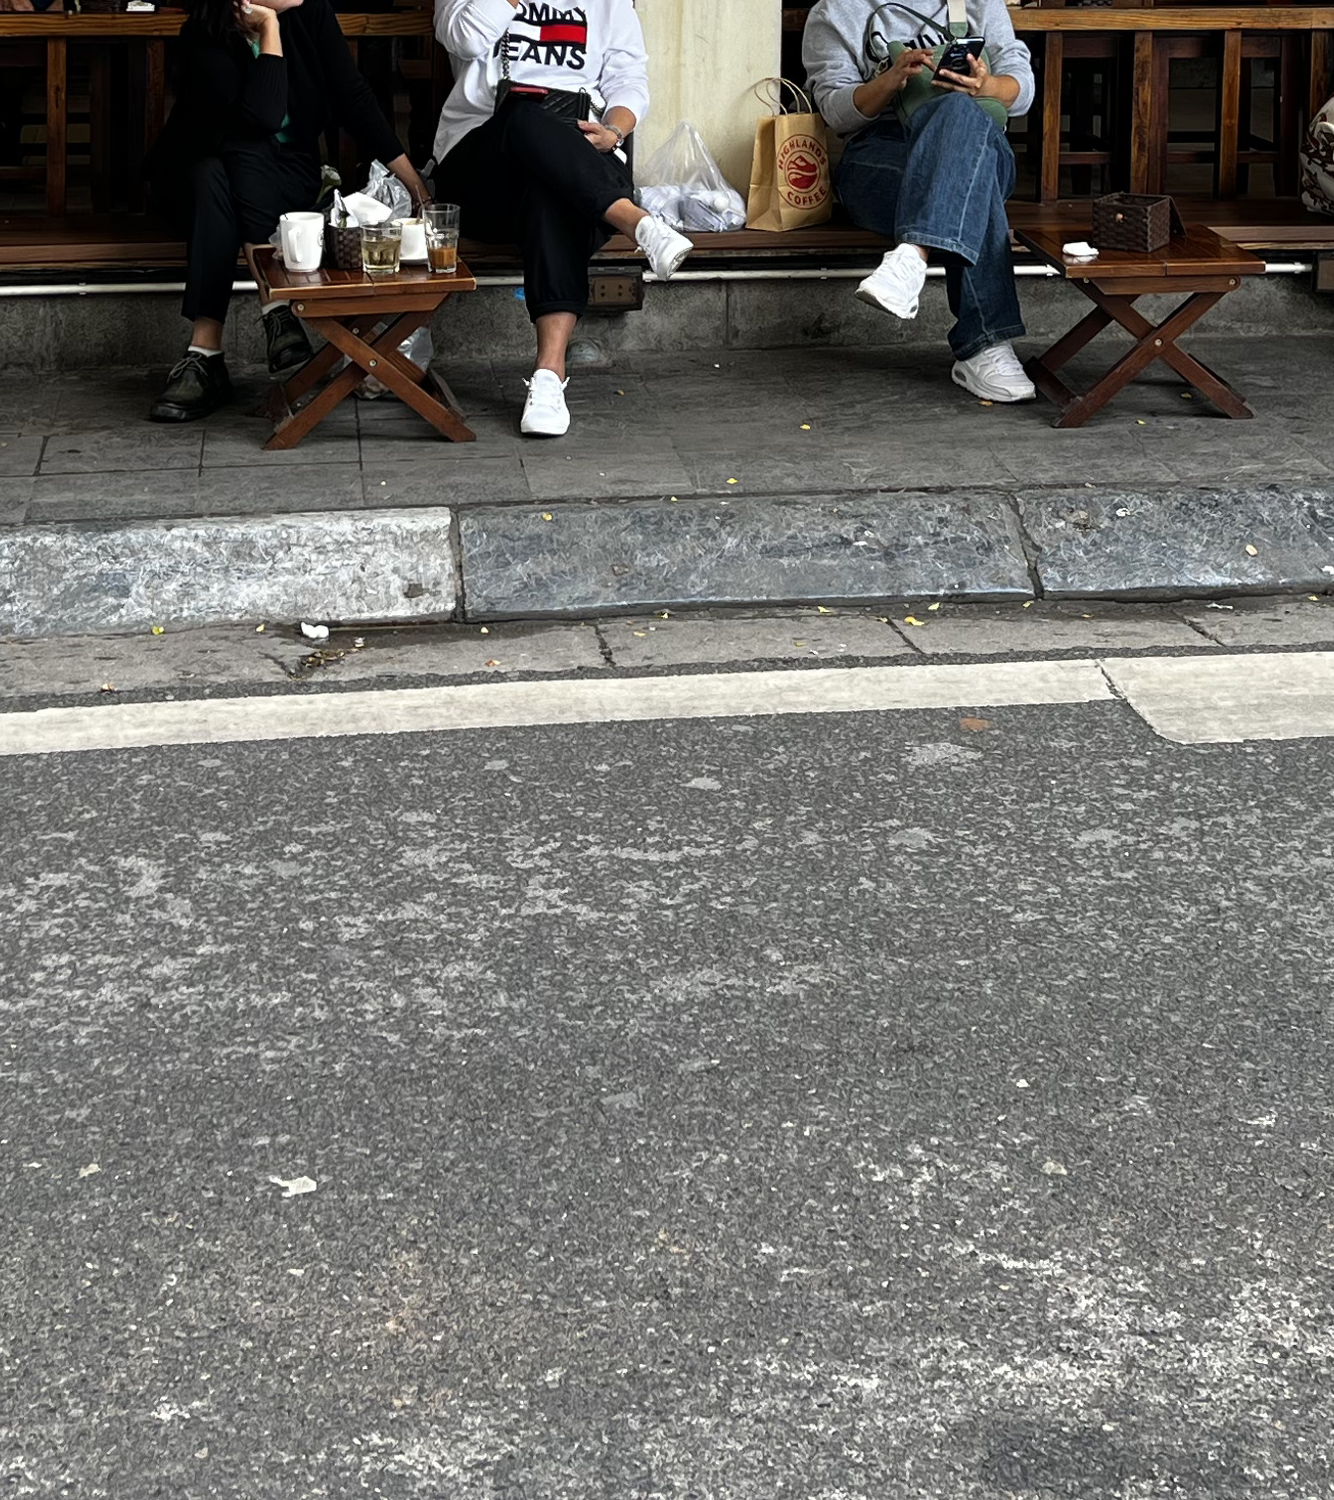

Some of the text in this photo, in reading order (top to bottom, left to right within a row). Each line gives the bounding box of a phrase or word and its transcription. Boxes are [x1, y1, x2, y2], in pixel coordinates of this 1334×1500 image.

[514, 1, 587, 24] OMMY
[778, 138, 827, 171] HIGHLANDS
[787, 186, 827, 205] COFFEE
